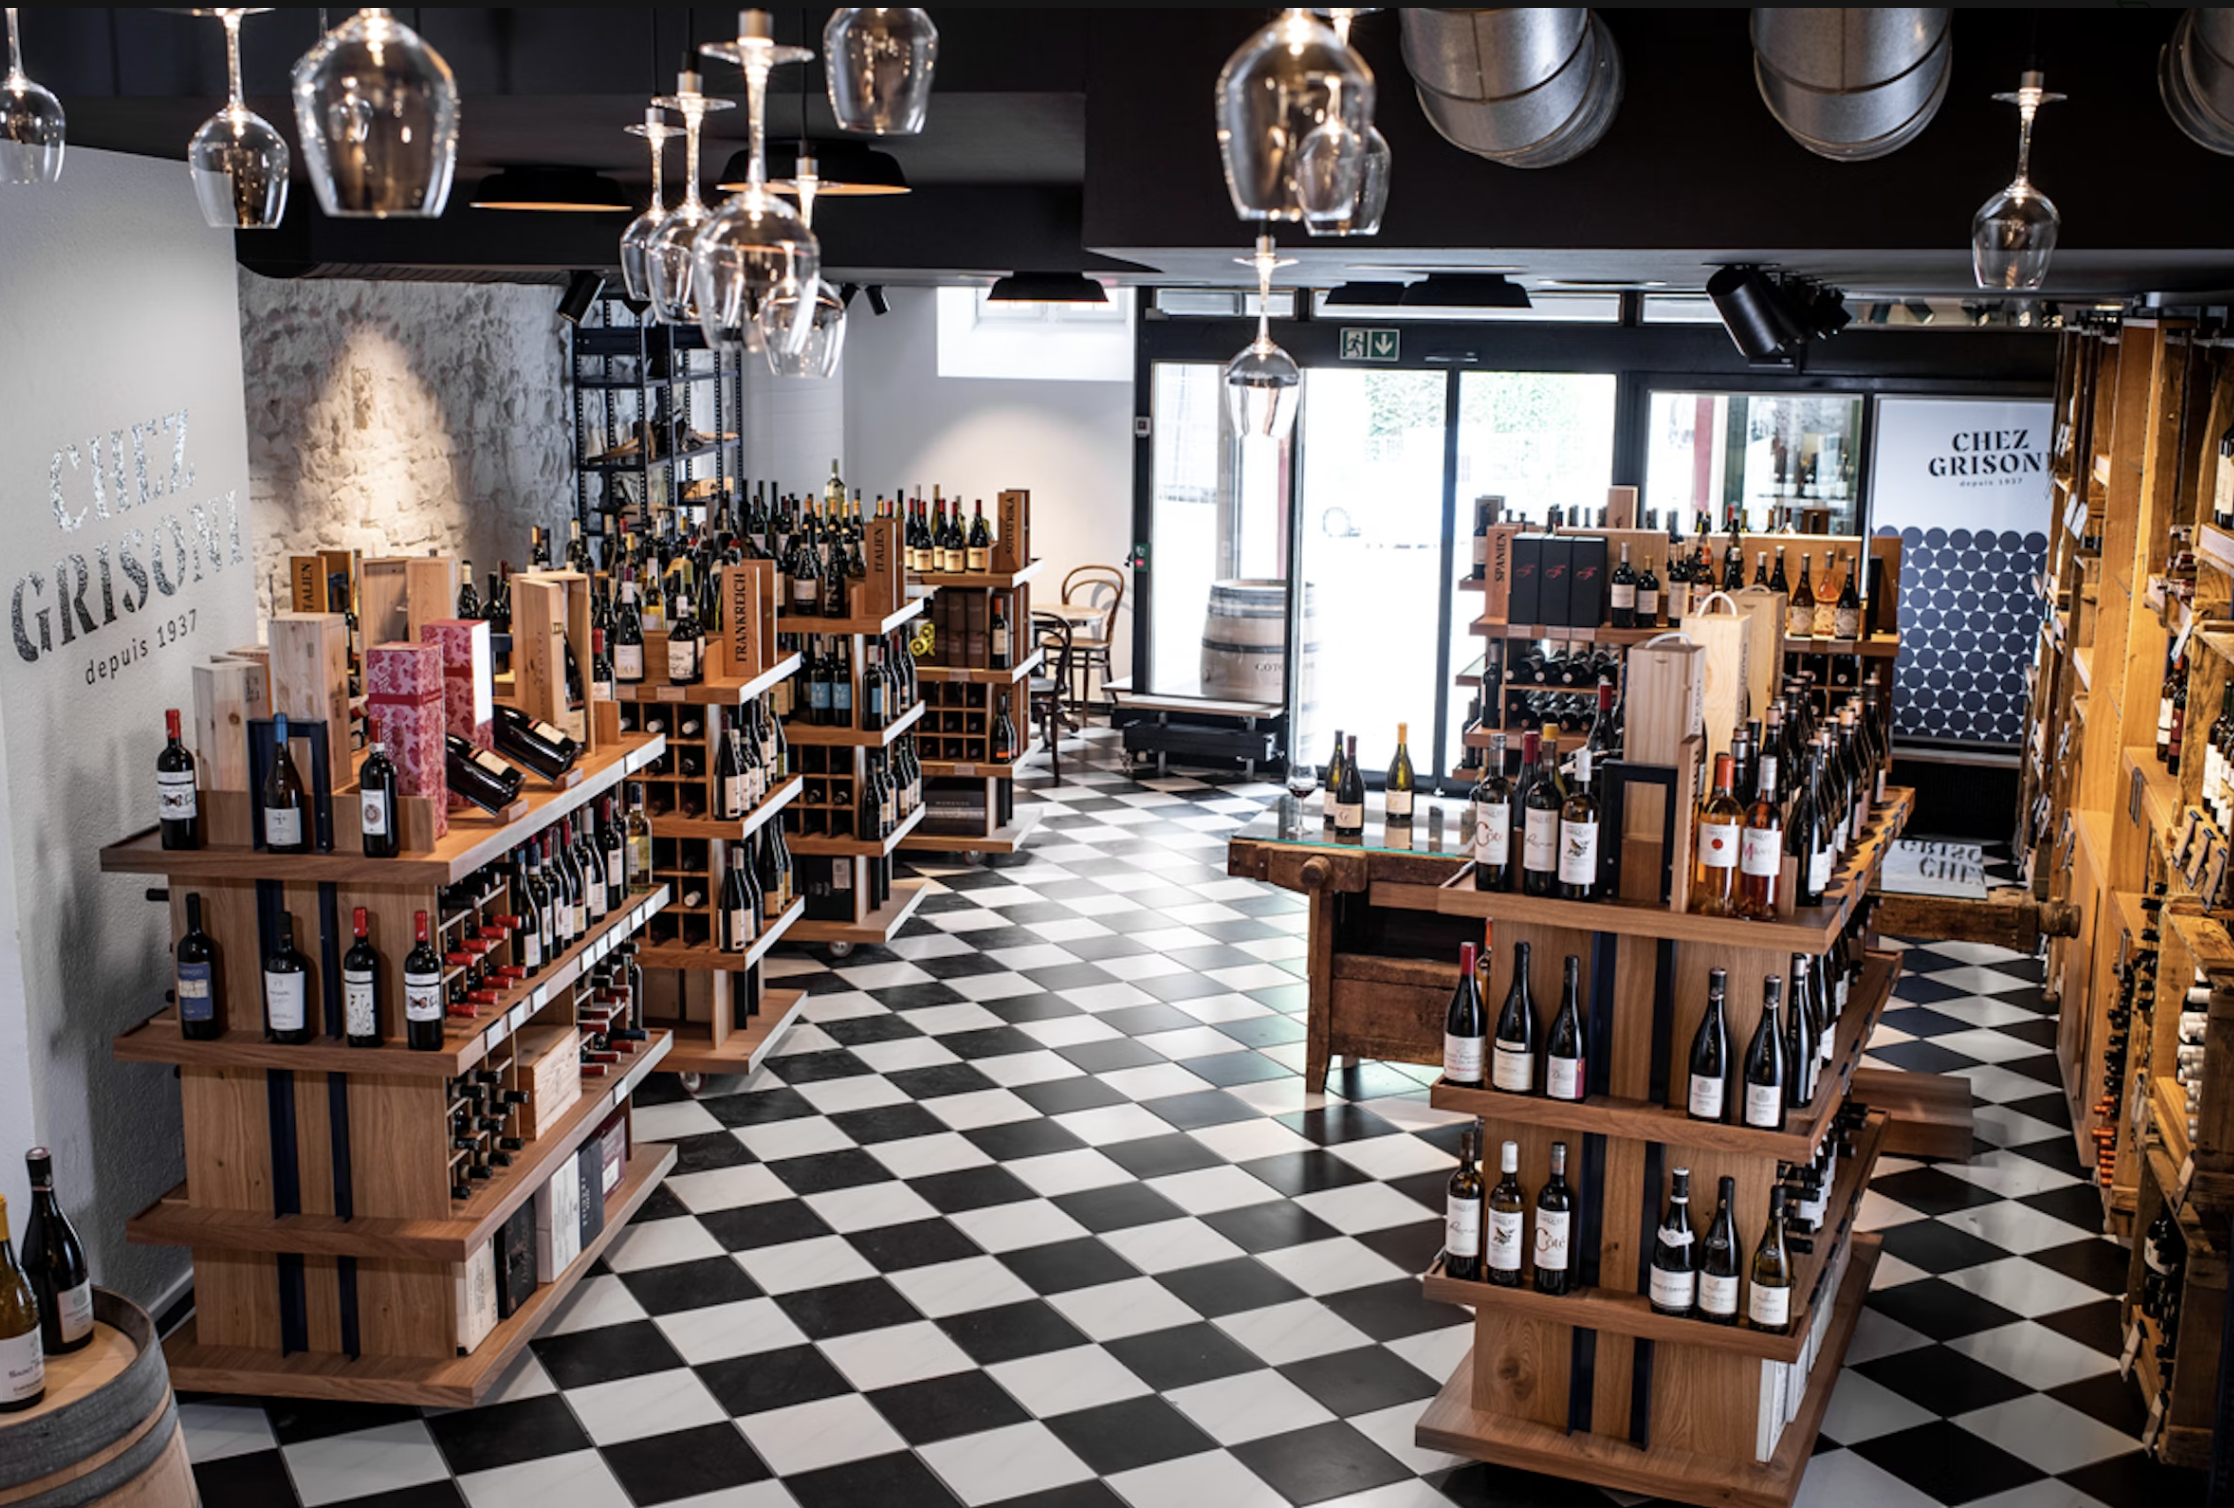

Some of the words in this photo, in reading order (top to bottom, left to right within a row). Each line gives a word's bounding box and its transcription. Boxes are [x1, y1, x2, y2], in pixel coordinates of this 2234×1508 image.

[1952, 429, 2030, 452] CHEZ
[50, 408, 196, 533] CHEZ
[1999, 478, 2023, 486] 1937
[875, 526, 884, 573] ITALIEN
[1495, 532, 1506, 582] SPANIEN
[11, 489, 244, 664] GRISONI
[301, 562, 315, 612] TALIEN
[734, 573, 747, 662] FRANKREICH
[85, 639, 149, 685] depuis
[156, 608, 198, 649] 1937
